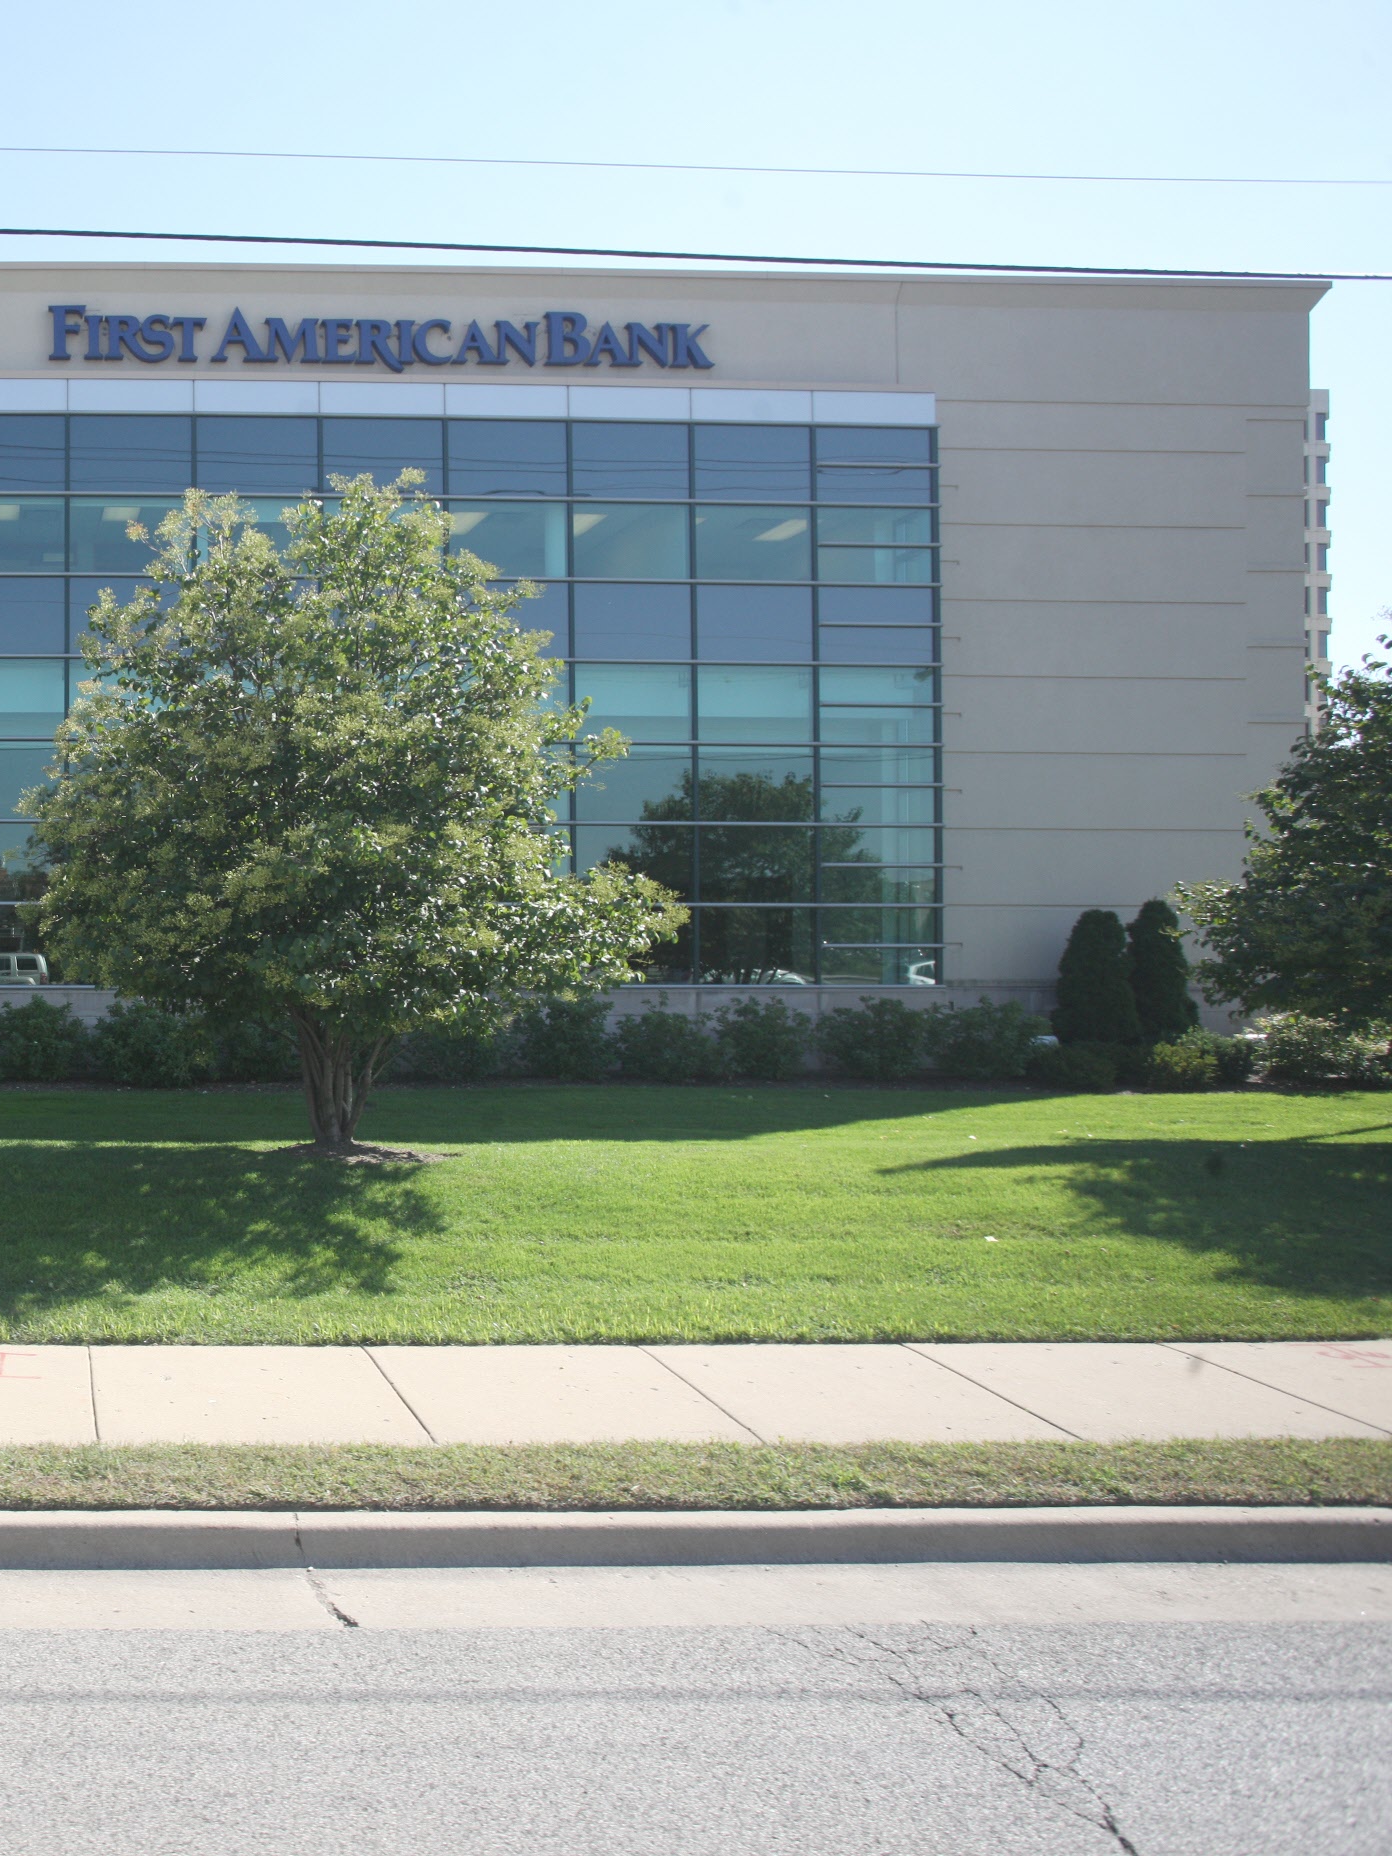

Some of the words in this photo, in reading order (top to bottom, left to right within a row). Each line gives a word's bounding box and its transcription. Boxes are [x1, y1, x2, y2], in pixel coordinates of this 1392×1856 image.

[47, 304, 208, 363] FIRST
[209, 306, 540, 373] AMERICAN
[541, 311, 715, 370] BANK
